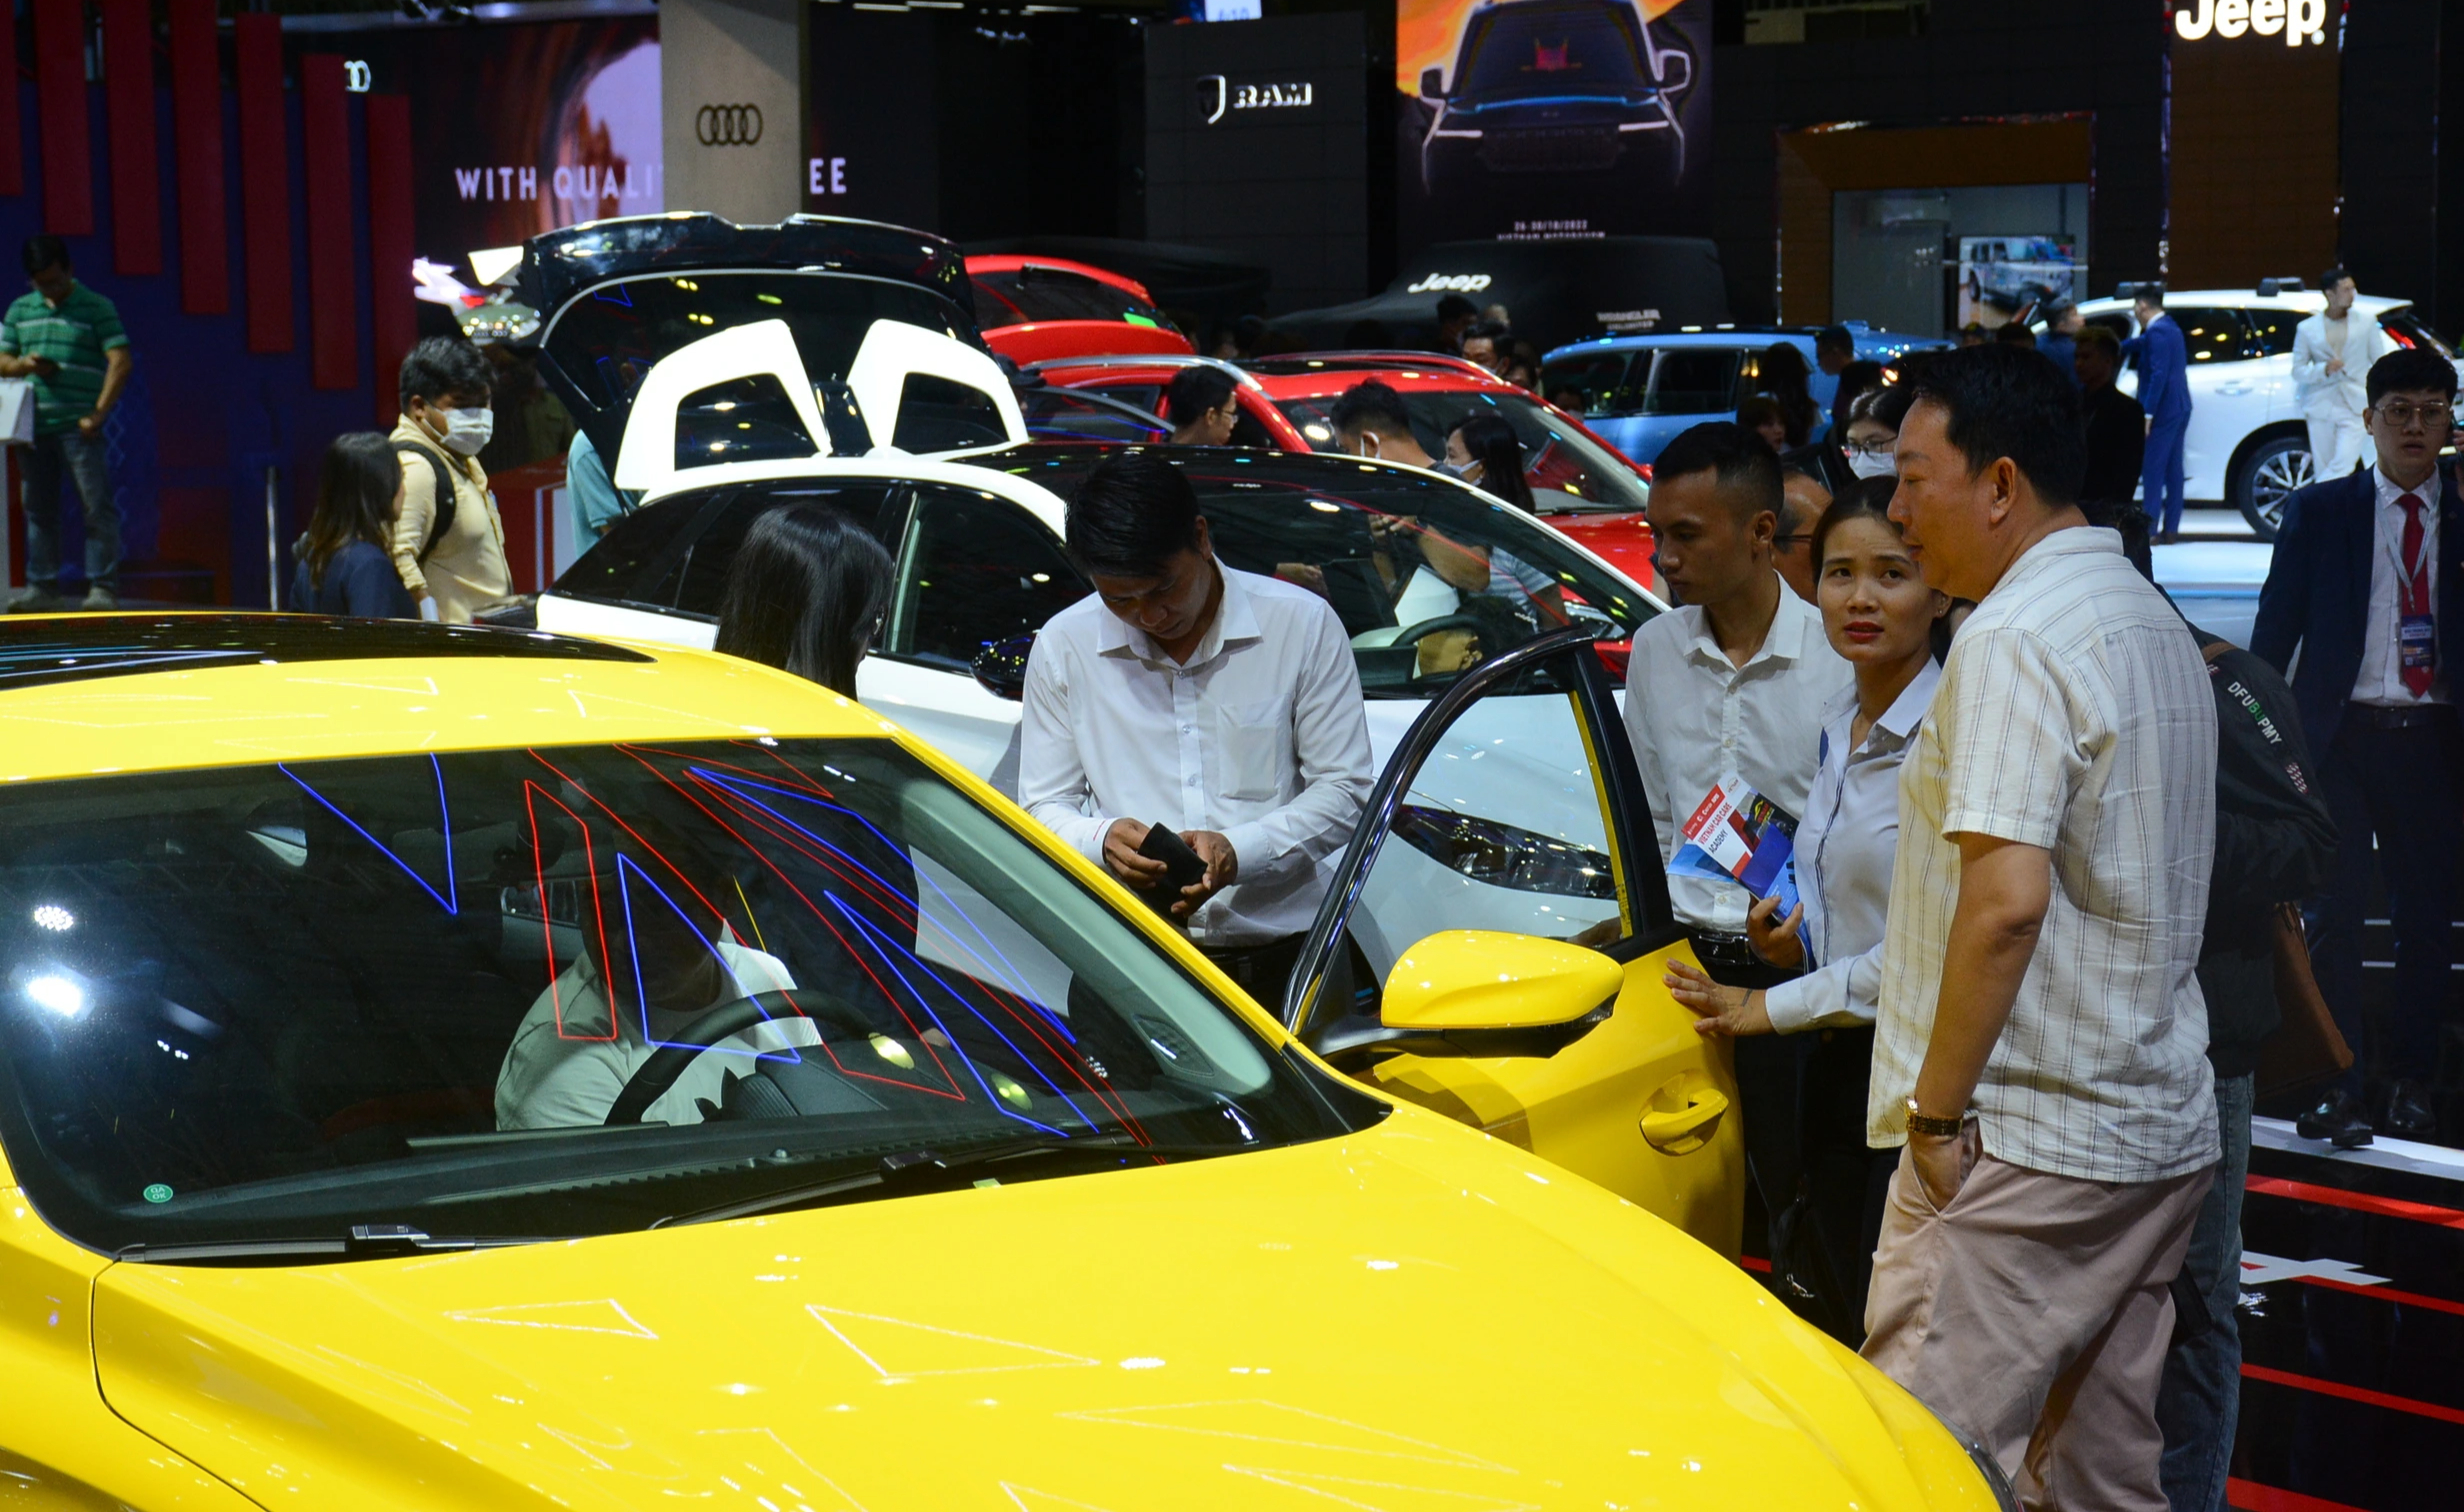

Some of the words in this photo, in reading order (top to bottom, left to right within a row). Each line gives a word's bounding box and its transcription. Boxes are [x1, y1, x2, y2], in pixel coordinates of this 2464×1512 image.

[2175, 0, 2326, 47] Jeep
[1233, 83, 1312, 108] RAM
[455, 166, 537, 200] WITH
[553, 165, 663, 200] QUALI
[809, 157, 847, 194] EE
[1407, 272, 1491, 293] Jeep
[2227, 681, 2282, 744] DFUBUPMY
[1697, 822, 1718, 845] VIETNAM
[1712, 813, 1724, 827] CAR
[1718, 801, 1733, 818] CARE
[1707, 829, 1729, 854] ACADEMY
